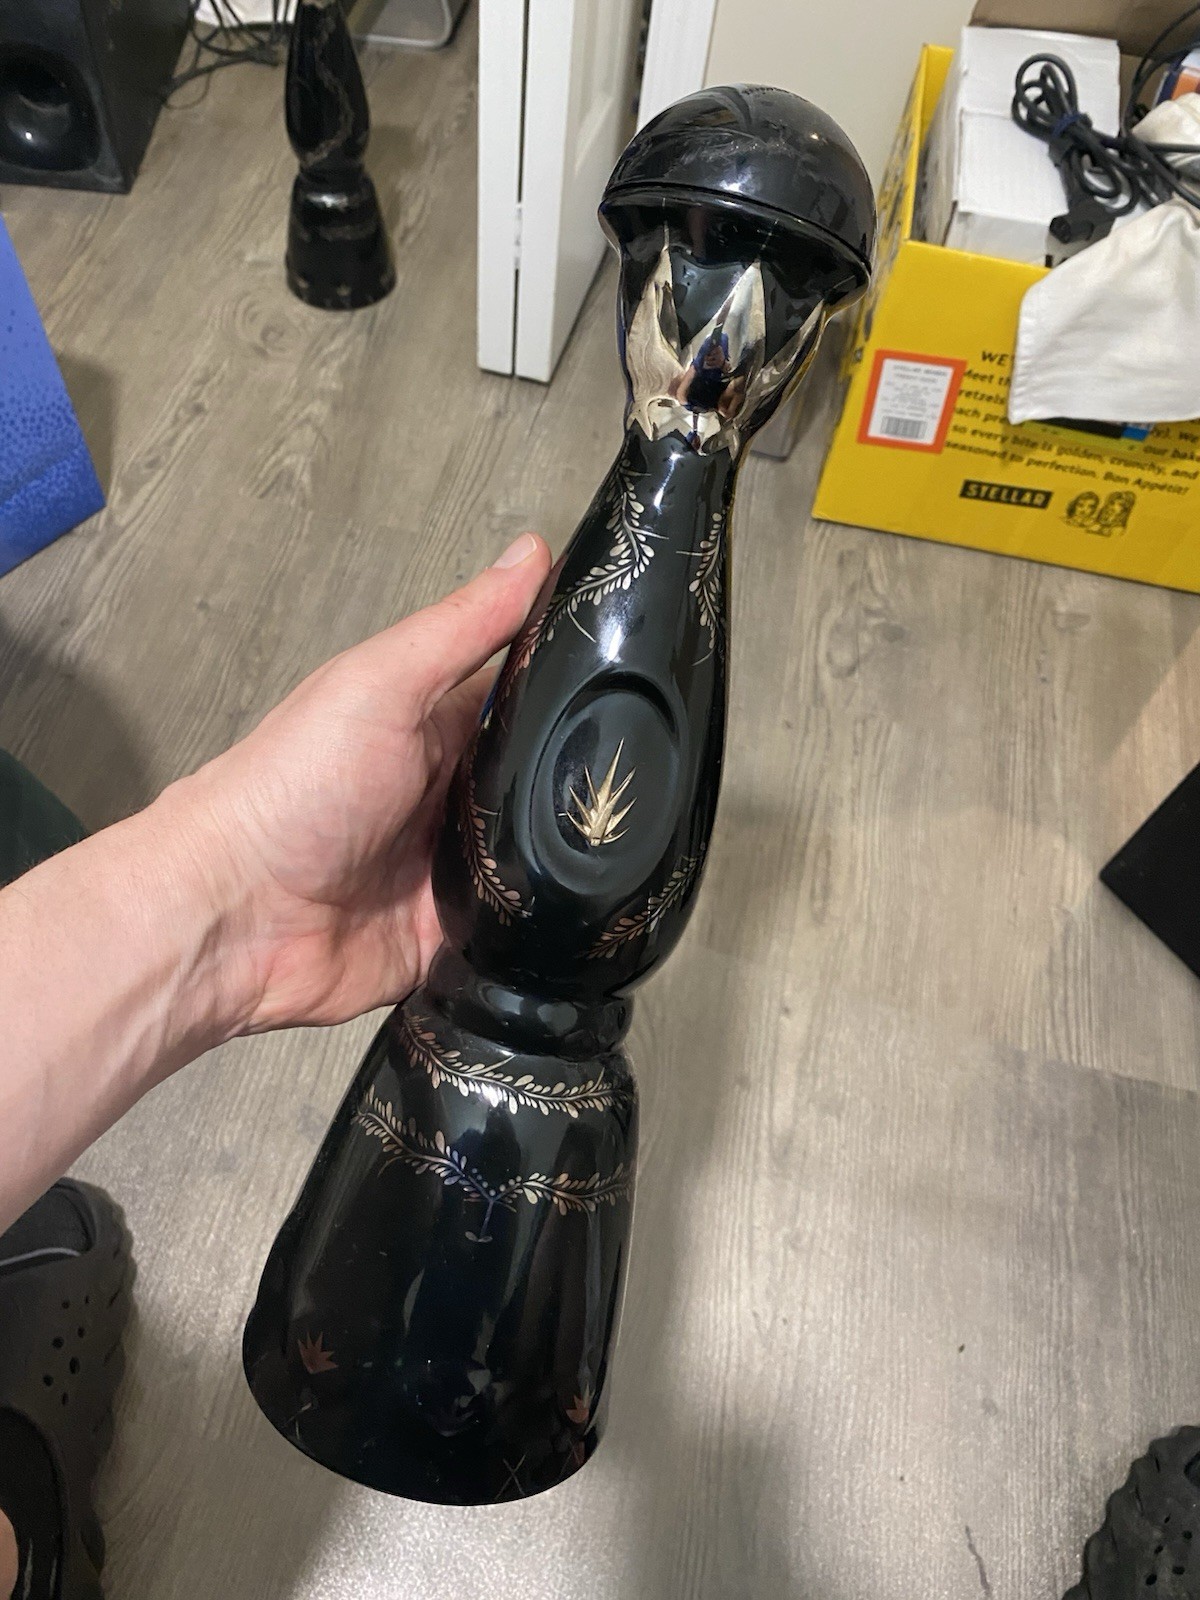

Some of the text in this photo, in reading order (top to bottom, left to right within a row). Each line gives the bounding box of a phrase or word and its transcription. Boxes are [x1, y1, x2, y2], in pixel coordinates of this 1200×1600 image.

[959, 389, 1006, 405] retzels
[971, 429, 1009, 444] every
[964, 483, 1049, 507] STELLAR
